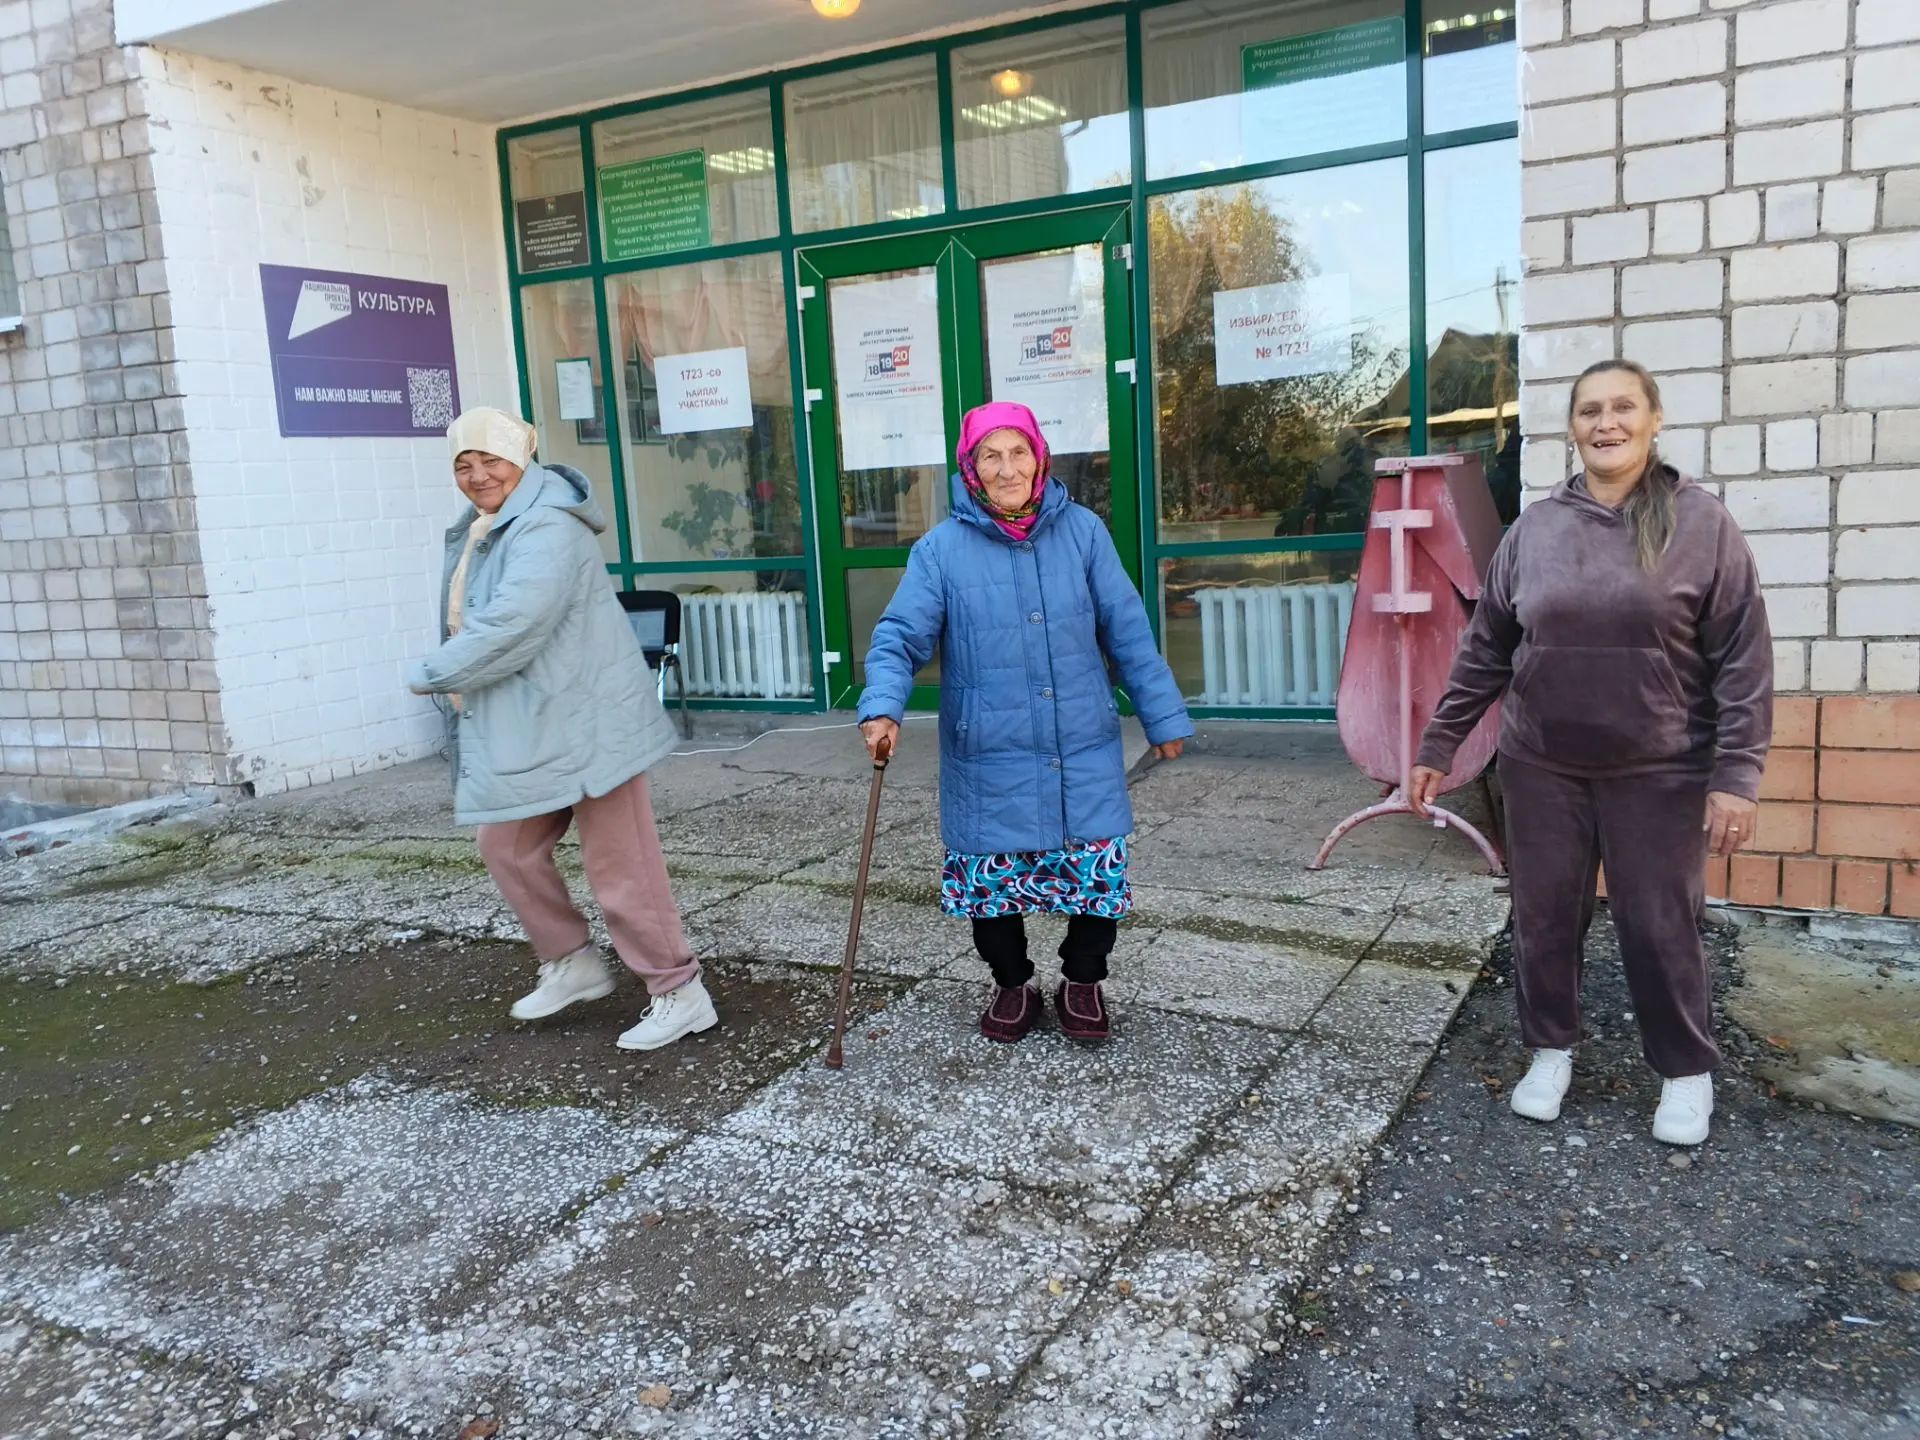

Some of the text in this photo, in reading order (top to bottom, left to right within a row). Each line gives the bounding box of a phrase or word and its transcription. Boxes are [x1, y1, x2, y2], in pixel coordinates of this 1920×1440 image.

[304, 282, 436, 316] НАЦИОНАЛЬНЫЕ КУЛЬТУРА
[324, 293, 350, 302] ПРОЕКТЫ
[330, 302, 350, 312] РОССИИ
[1025, 332, 1068, 360] 18 19 20
[1256, 346, 1272, 359] №
[868, 350, 908, 376] 18 19 20
[680, 368, 704, 381] 1723
[295, 387, 403, 404] НАМ ВАЖНО ВАШЕ МНЕНИЕ
